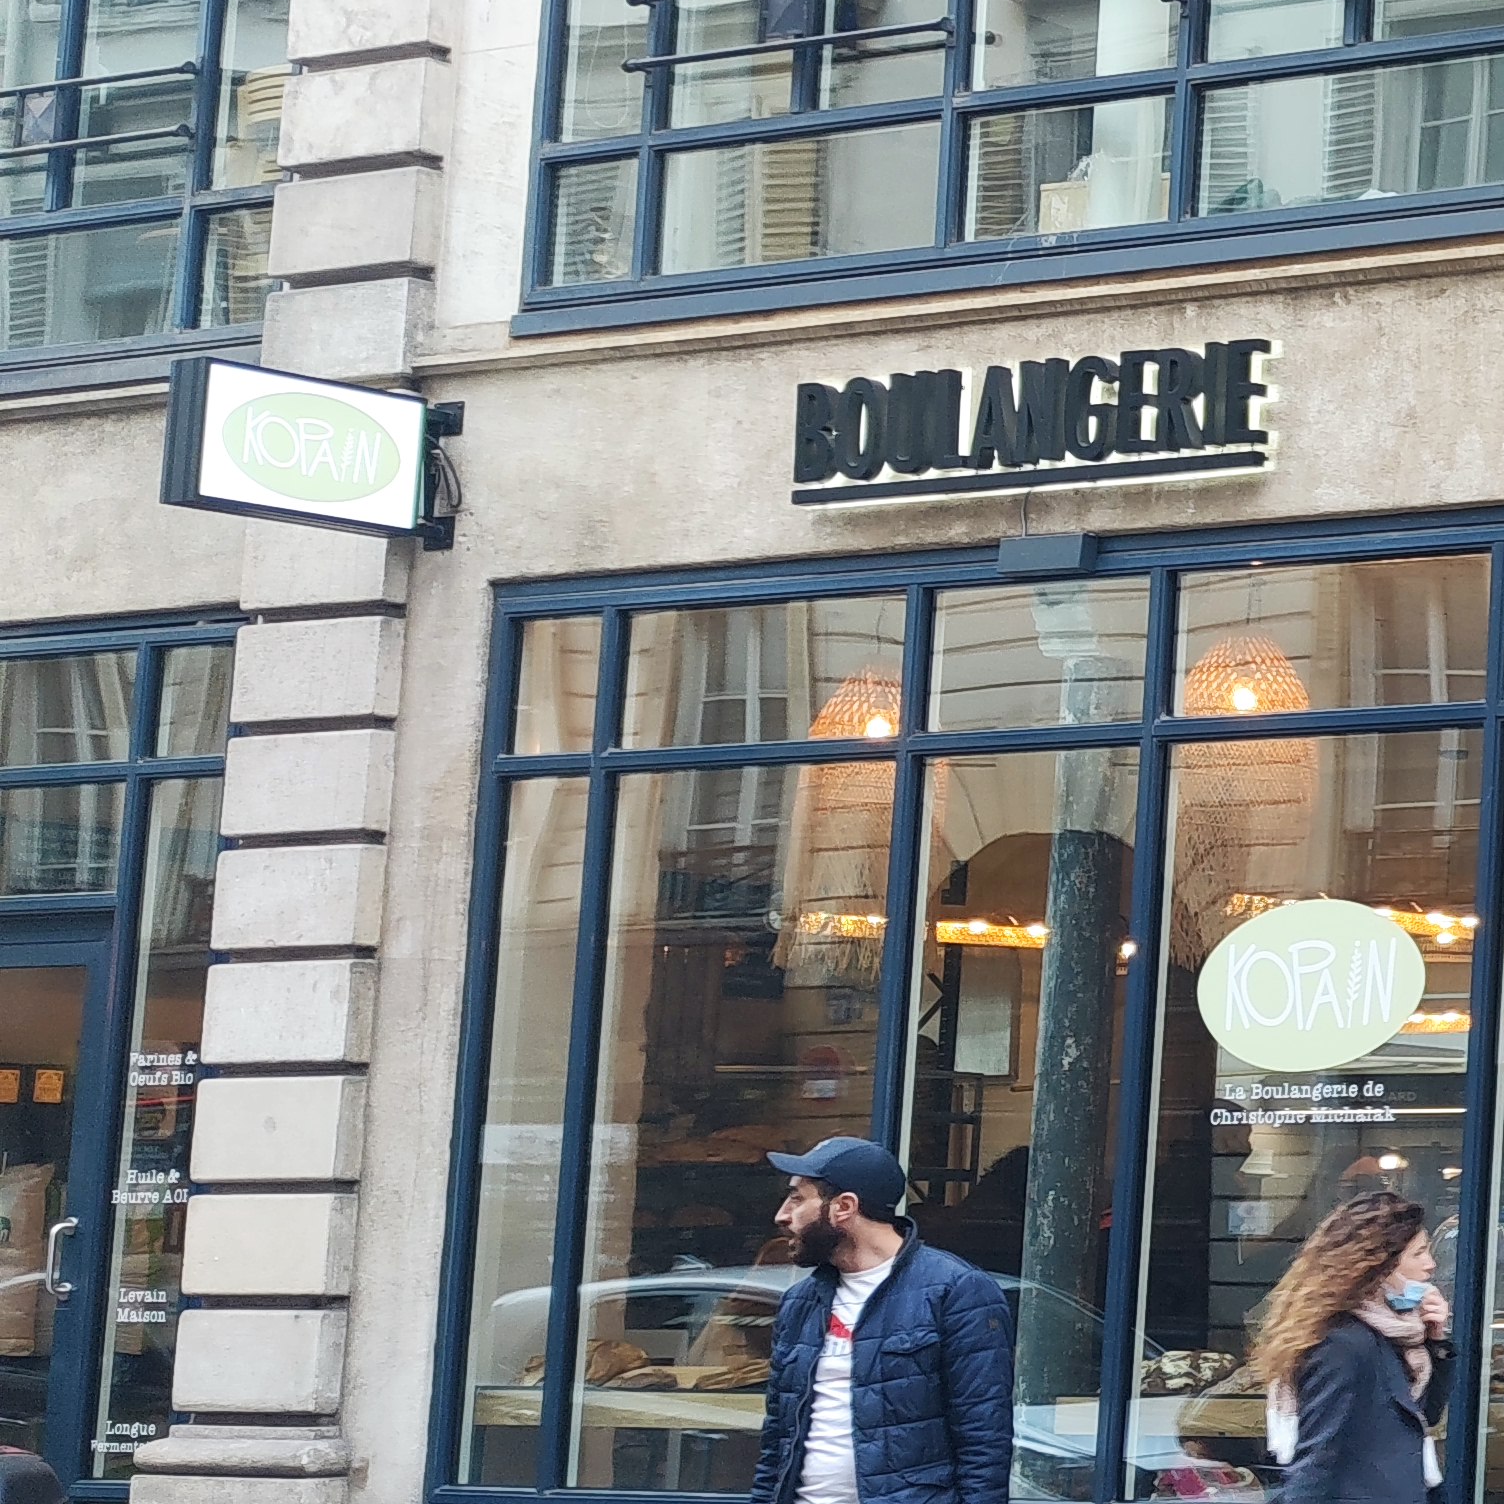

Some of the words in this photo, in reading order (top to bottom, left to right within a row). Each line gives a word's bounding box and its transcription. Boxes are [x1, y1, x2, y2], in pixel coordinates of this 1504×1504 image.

[792, 338, 1272, 484] BOULANGERIE
[130, 1052, 182, 1067] Farines
[185, 1050, 197, 1065] &
[130, 1071, 168, 1087] Oeufs
[171, 1070, 194, 1085] Bio
[1224, 1084, 1246, 1100] La
[1250, 1082, 1359, 1102] Boulangerie
[1363, 1081, 1385, 1097] de
[1210, 1107, 1305, 1127] Christophe
[126, 1169, 165, 1184] Huile
[168, 1168, 180, 1183] &
[111, 1189, 160, 1204] Beurre
[119, 1287, 167, 1304] Levain
[116, 1307, 166, 1323] Maison
